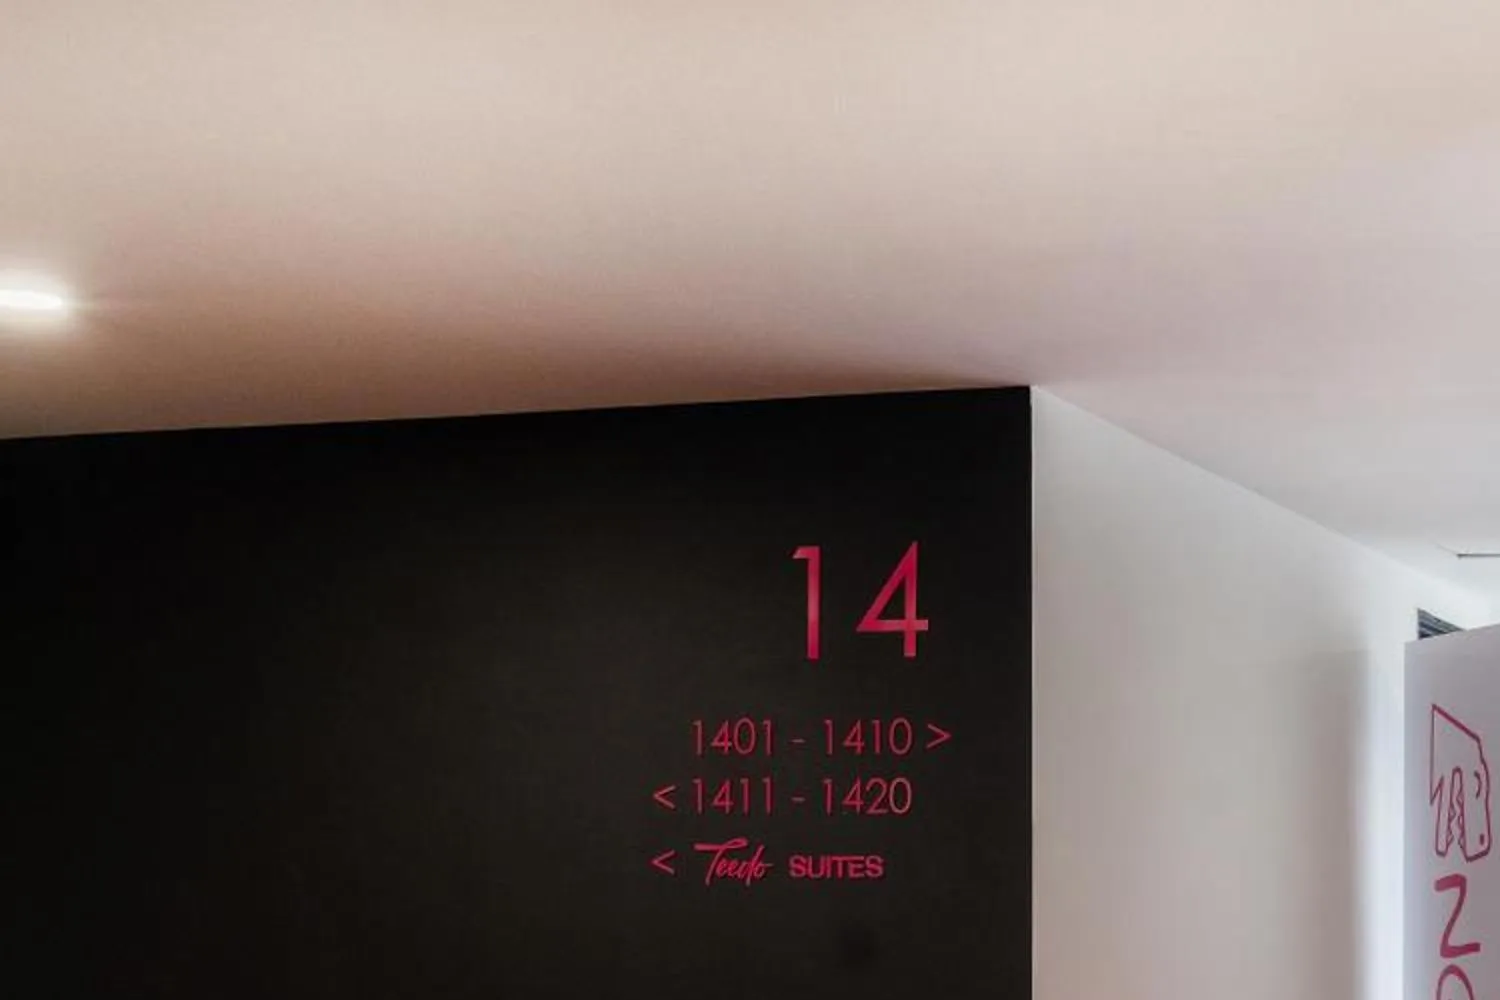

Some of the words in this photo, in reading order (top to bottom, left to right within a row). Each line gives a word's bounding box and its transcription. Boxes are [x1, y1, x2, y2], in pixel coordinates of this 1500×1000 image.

[792, 541, 930, 660] 14
[693, 718, 774, 756] 1401
[824, 717, 914, 756] 1410
[692, 777, 774, 815] 1411
[823, 777, 914, 815] 1420
[788, 854, 886, 879] SUITES
